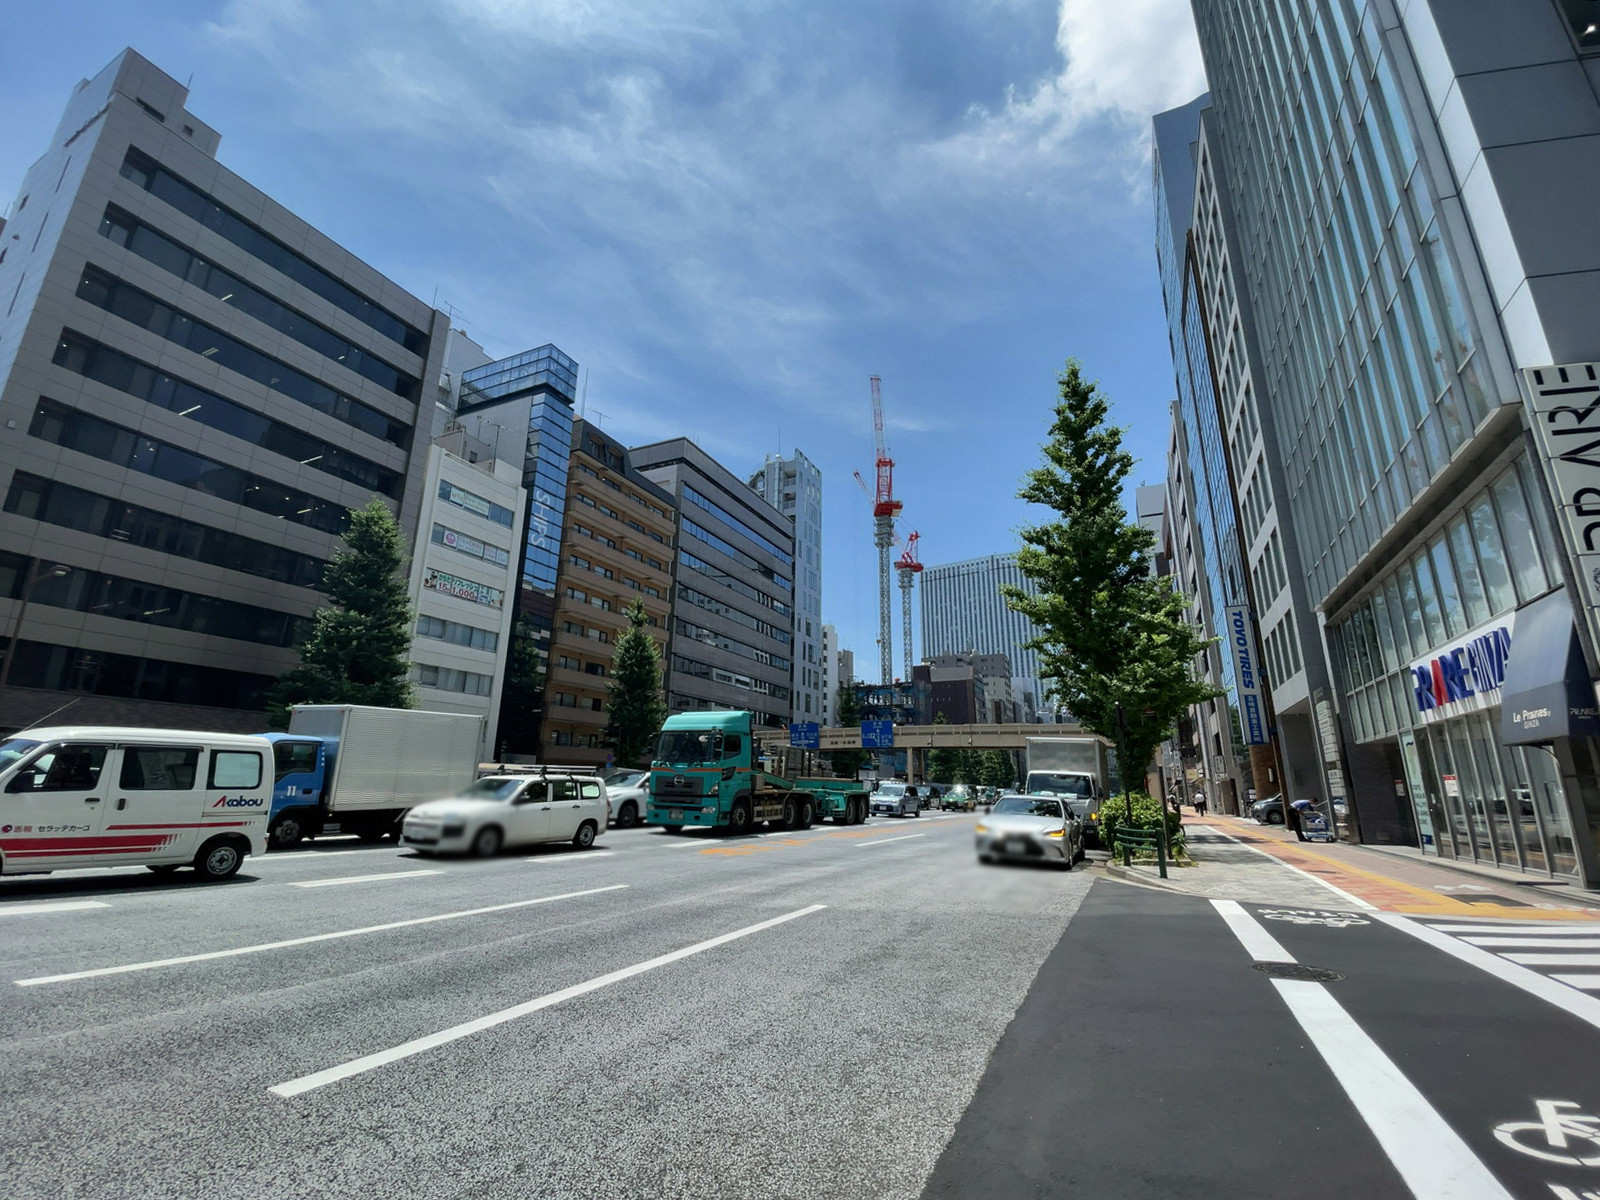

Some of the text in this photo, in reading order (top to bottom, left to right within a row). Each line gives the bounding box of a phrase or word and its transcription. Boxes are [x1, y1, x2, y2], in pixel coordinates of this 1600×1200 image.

[531, 490, 551, 548] SHIPS
[1512, 712, 1521, 723] Le
[286, 785, 297, 797] 11
[212, 795, 264, 808] Akabou
